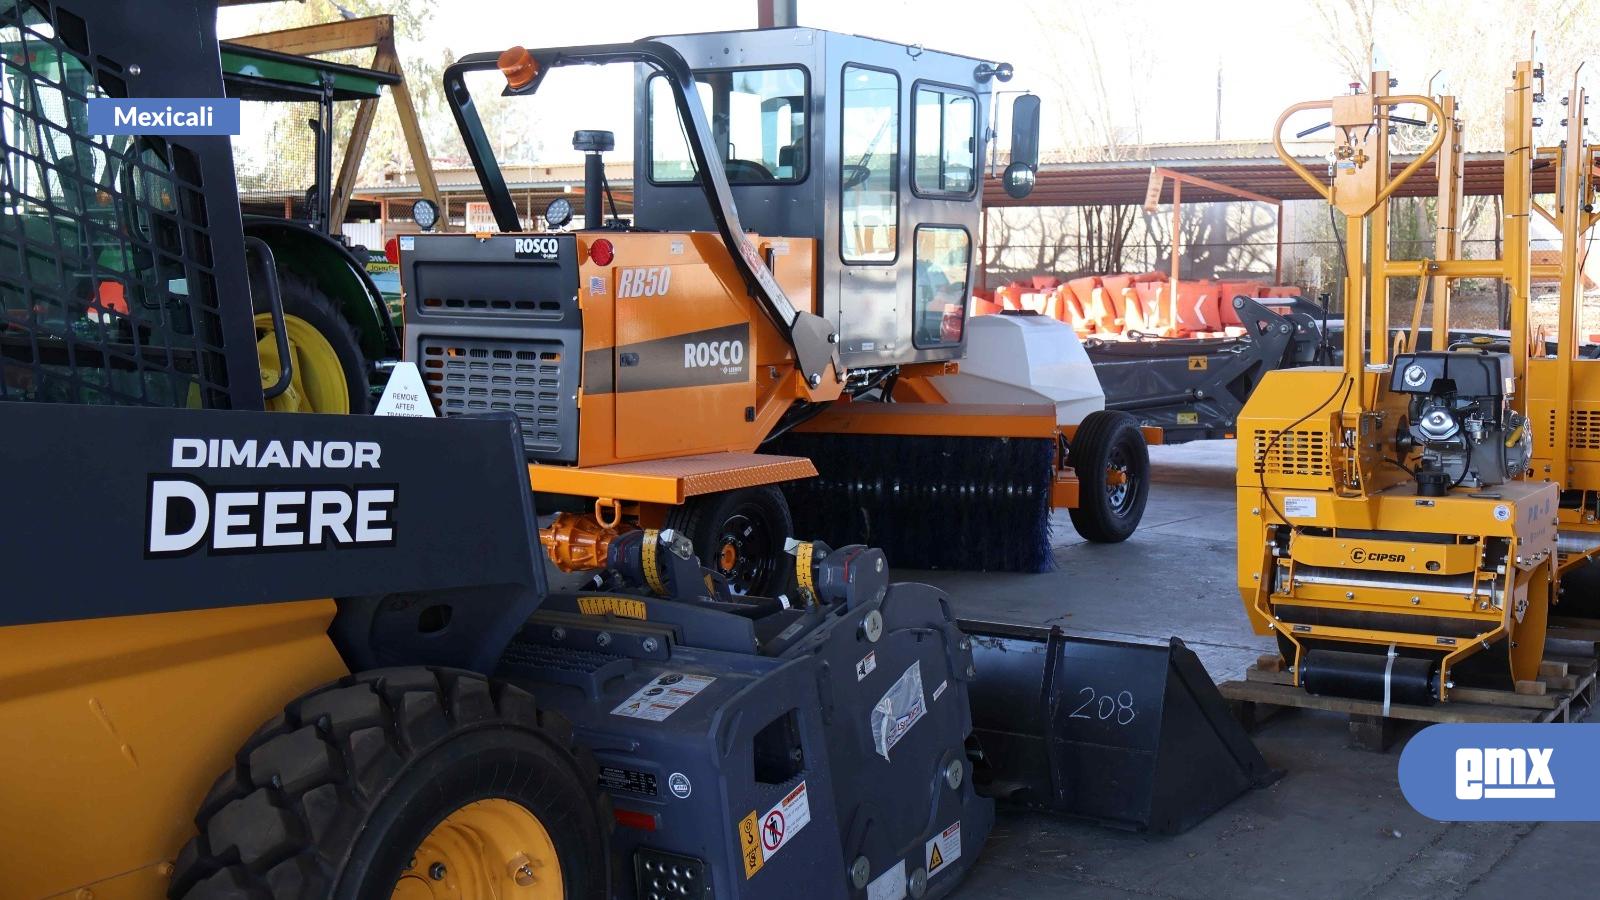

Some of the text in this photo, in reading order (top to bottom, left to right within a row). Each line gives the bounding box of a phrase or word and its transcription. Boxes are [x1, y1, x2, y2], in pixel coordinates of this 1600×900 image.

[515, 238, 559, 254] ROSCO
[618, 265, 672, 299] RB50
[684, 340, 743, 368] ROSCO
[392, 393, 419, 401] REMOVE
[395, 403, 415, 411] AFTER
[172, 438, 381, 468] DIMANOR
[150, 480, 395, 552] DEERE
[1368, 552, 1406, 563] CIPSA
[1068, 687, 1135, 725] 208
